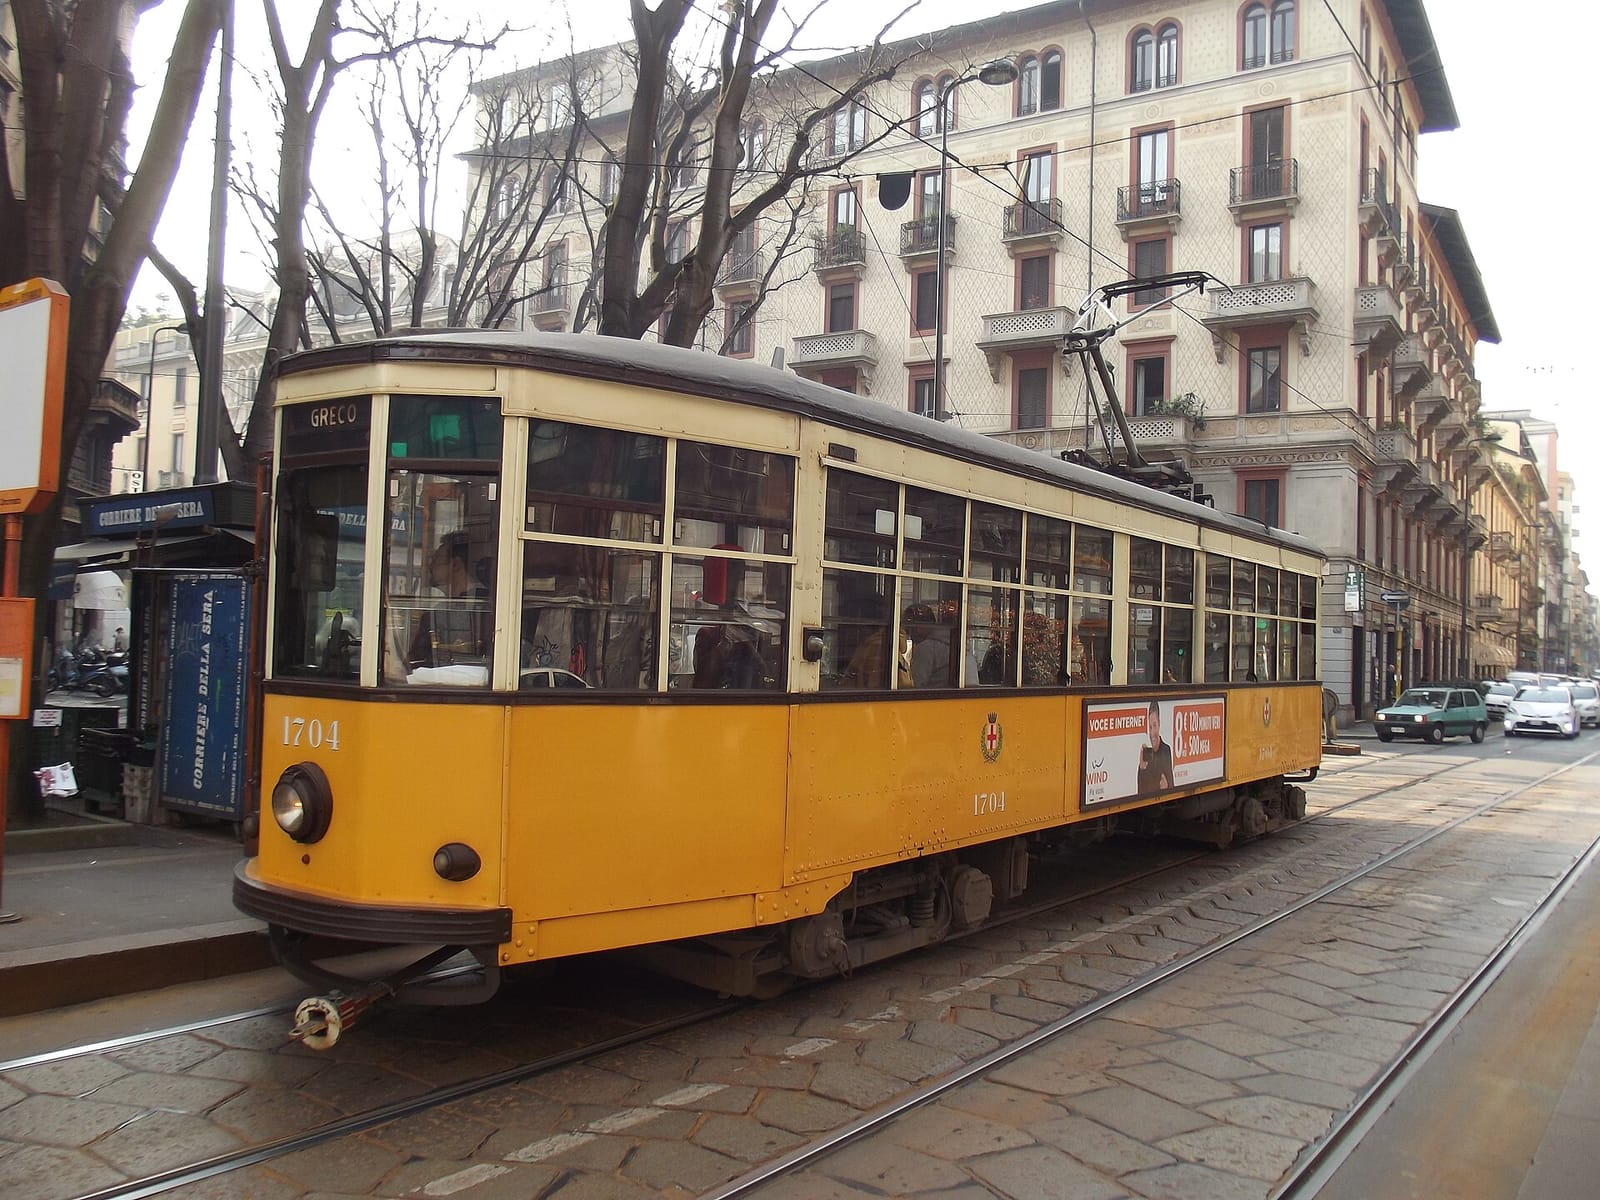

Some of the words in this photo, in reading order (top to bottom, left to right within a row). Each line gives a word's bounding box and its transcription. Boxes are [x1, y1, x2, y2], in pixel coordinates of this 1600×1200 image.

[311, 404, 357, 427] GRECO
[99, 508, 142, 527] CORRIERE
[177, 501, 204, 518] SERA
[339, 513, 366, 526] DELL
[201, 590, 214, 635] SERA
[198, 642, 210, 697] DELLA
[1089, 718, 1109, 732] VOCE
[1109, 717, 1114, 730] E
[1115, 715, 1146, 729] INTERNET
[1189, 711, 1199, 732] 120
[282, 716, 340, 752] 1704
[1175, 711, 1183, 759] 8
[193, 702, 208, 790] CORRIERE
[1189, 735, 1200, 757] 500
[1087, 771, 1108, 785] WIND
[974, 792, 1005, 815] 1704
